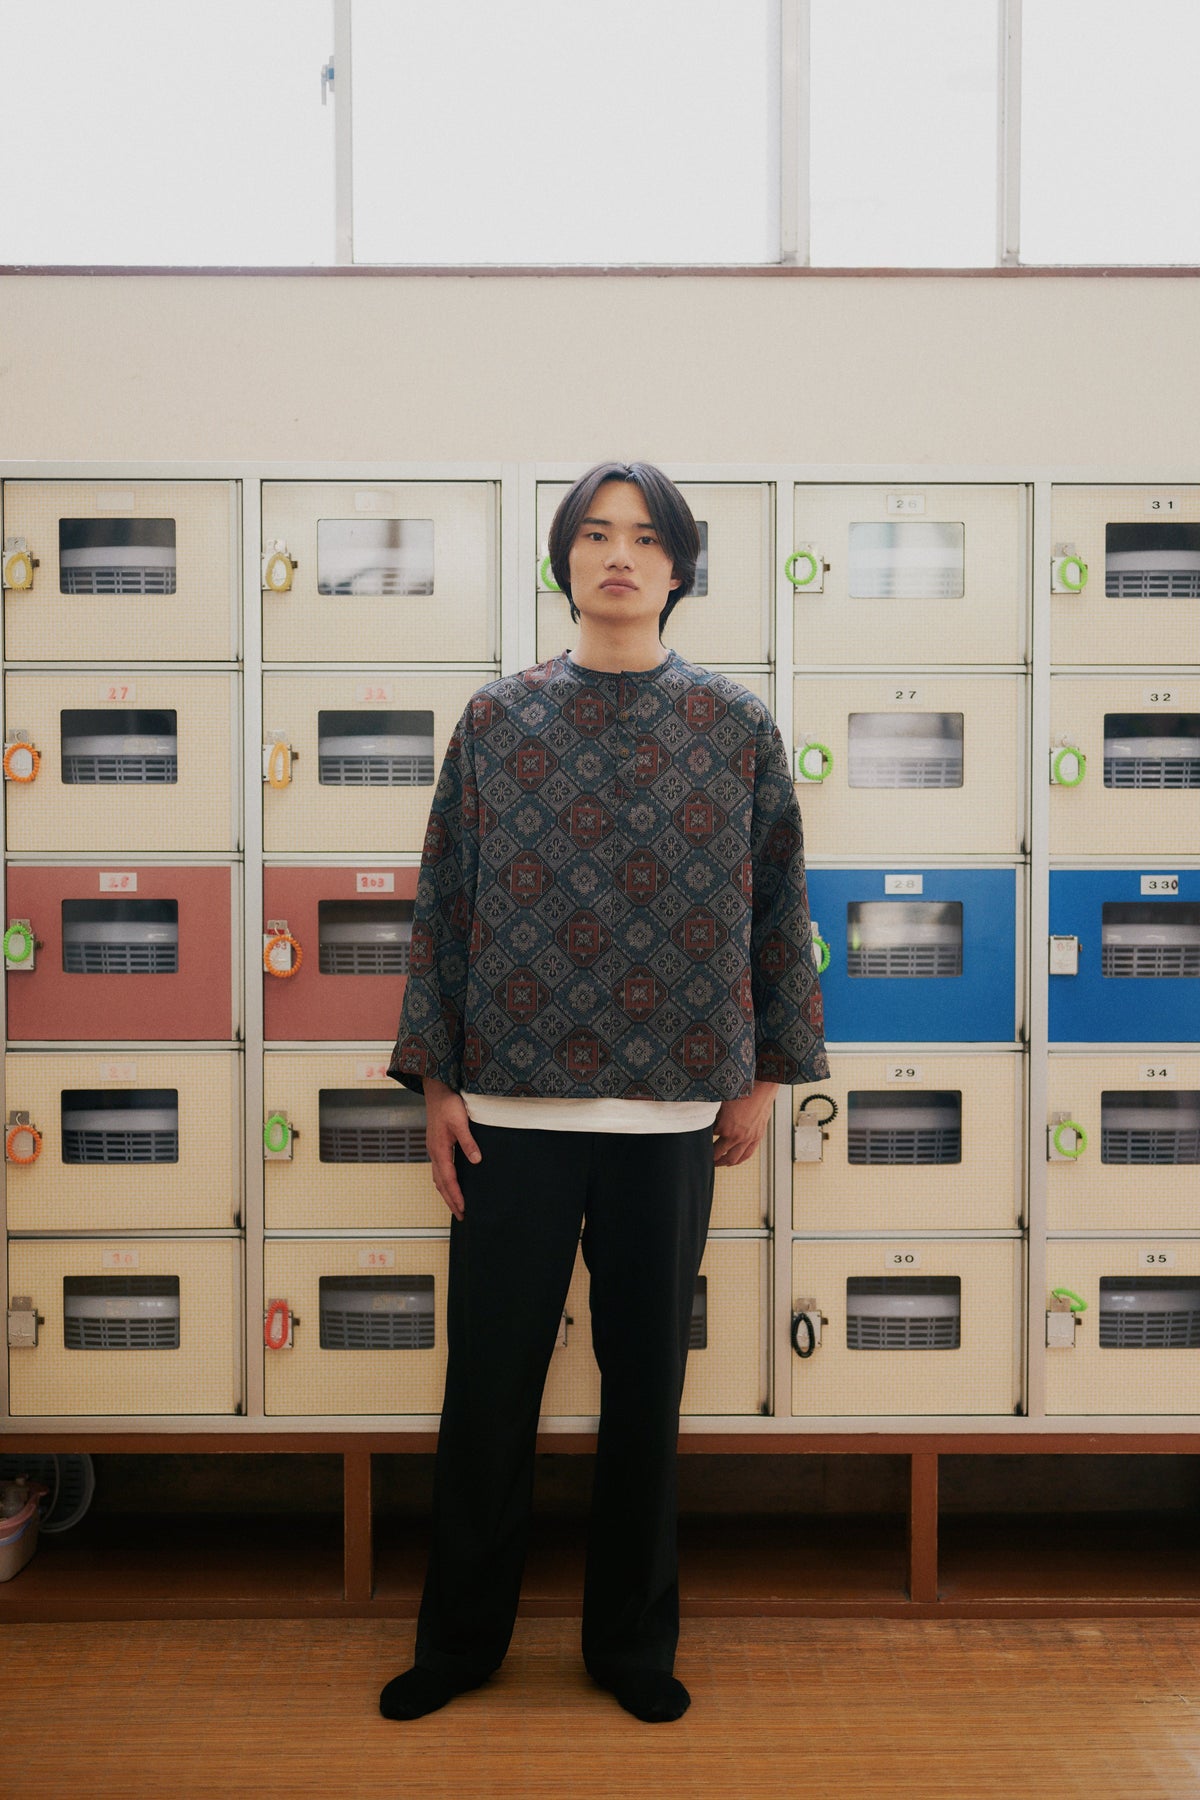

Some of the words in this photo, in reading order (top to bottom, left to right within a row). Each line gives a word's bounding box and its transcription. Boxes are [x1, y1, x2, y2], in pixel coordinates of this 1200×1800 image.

[1152, 501, 1173, 509] 31
[108, 687, 129, 700] 27
[896, 691, 917, 699] 27
[1151, 693, 1171, 702] 32
[895, 880, 915, 889] 28
[895, 1069, 915, 1077] 29
[1147, 1069, 1167, 1077] 34
[368, 1254, 387, 1265] 35
[894, 1255, 915, 1263] 30
[1146, 1255, 1167, 1263] 35
